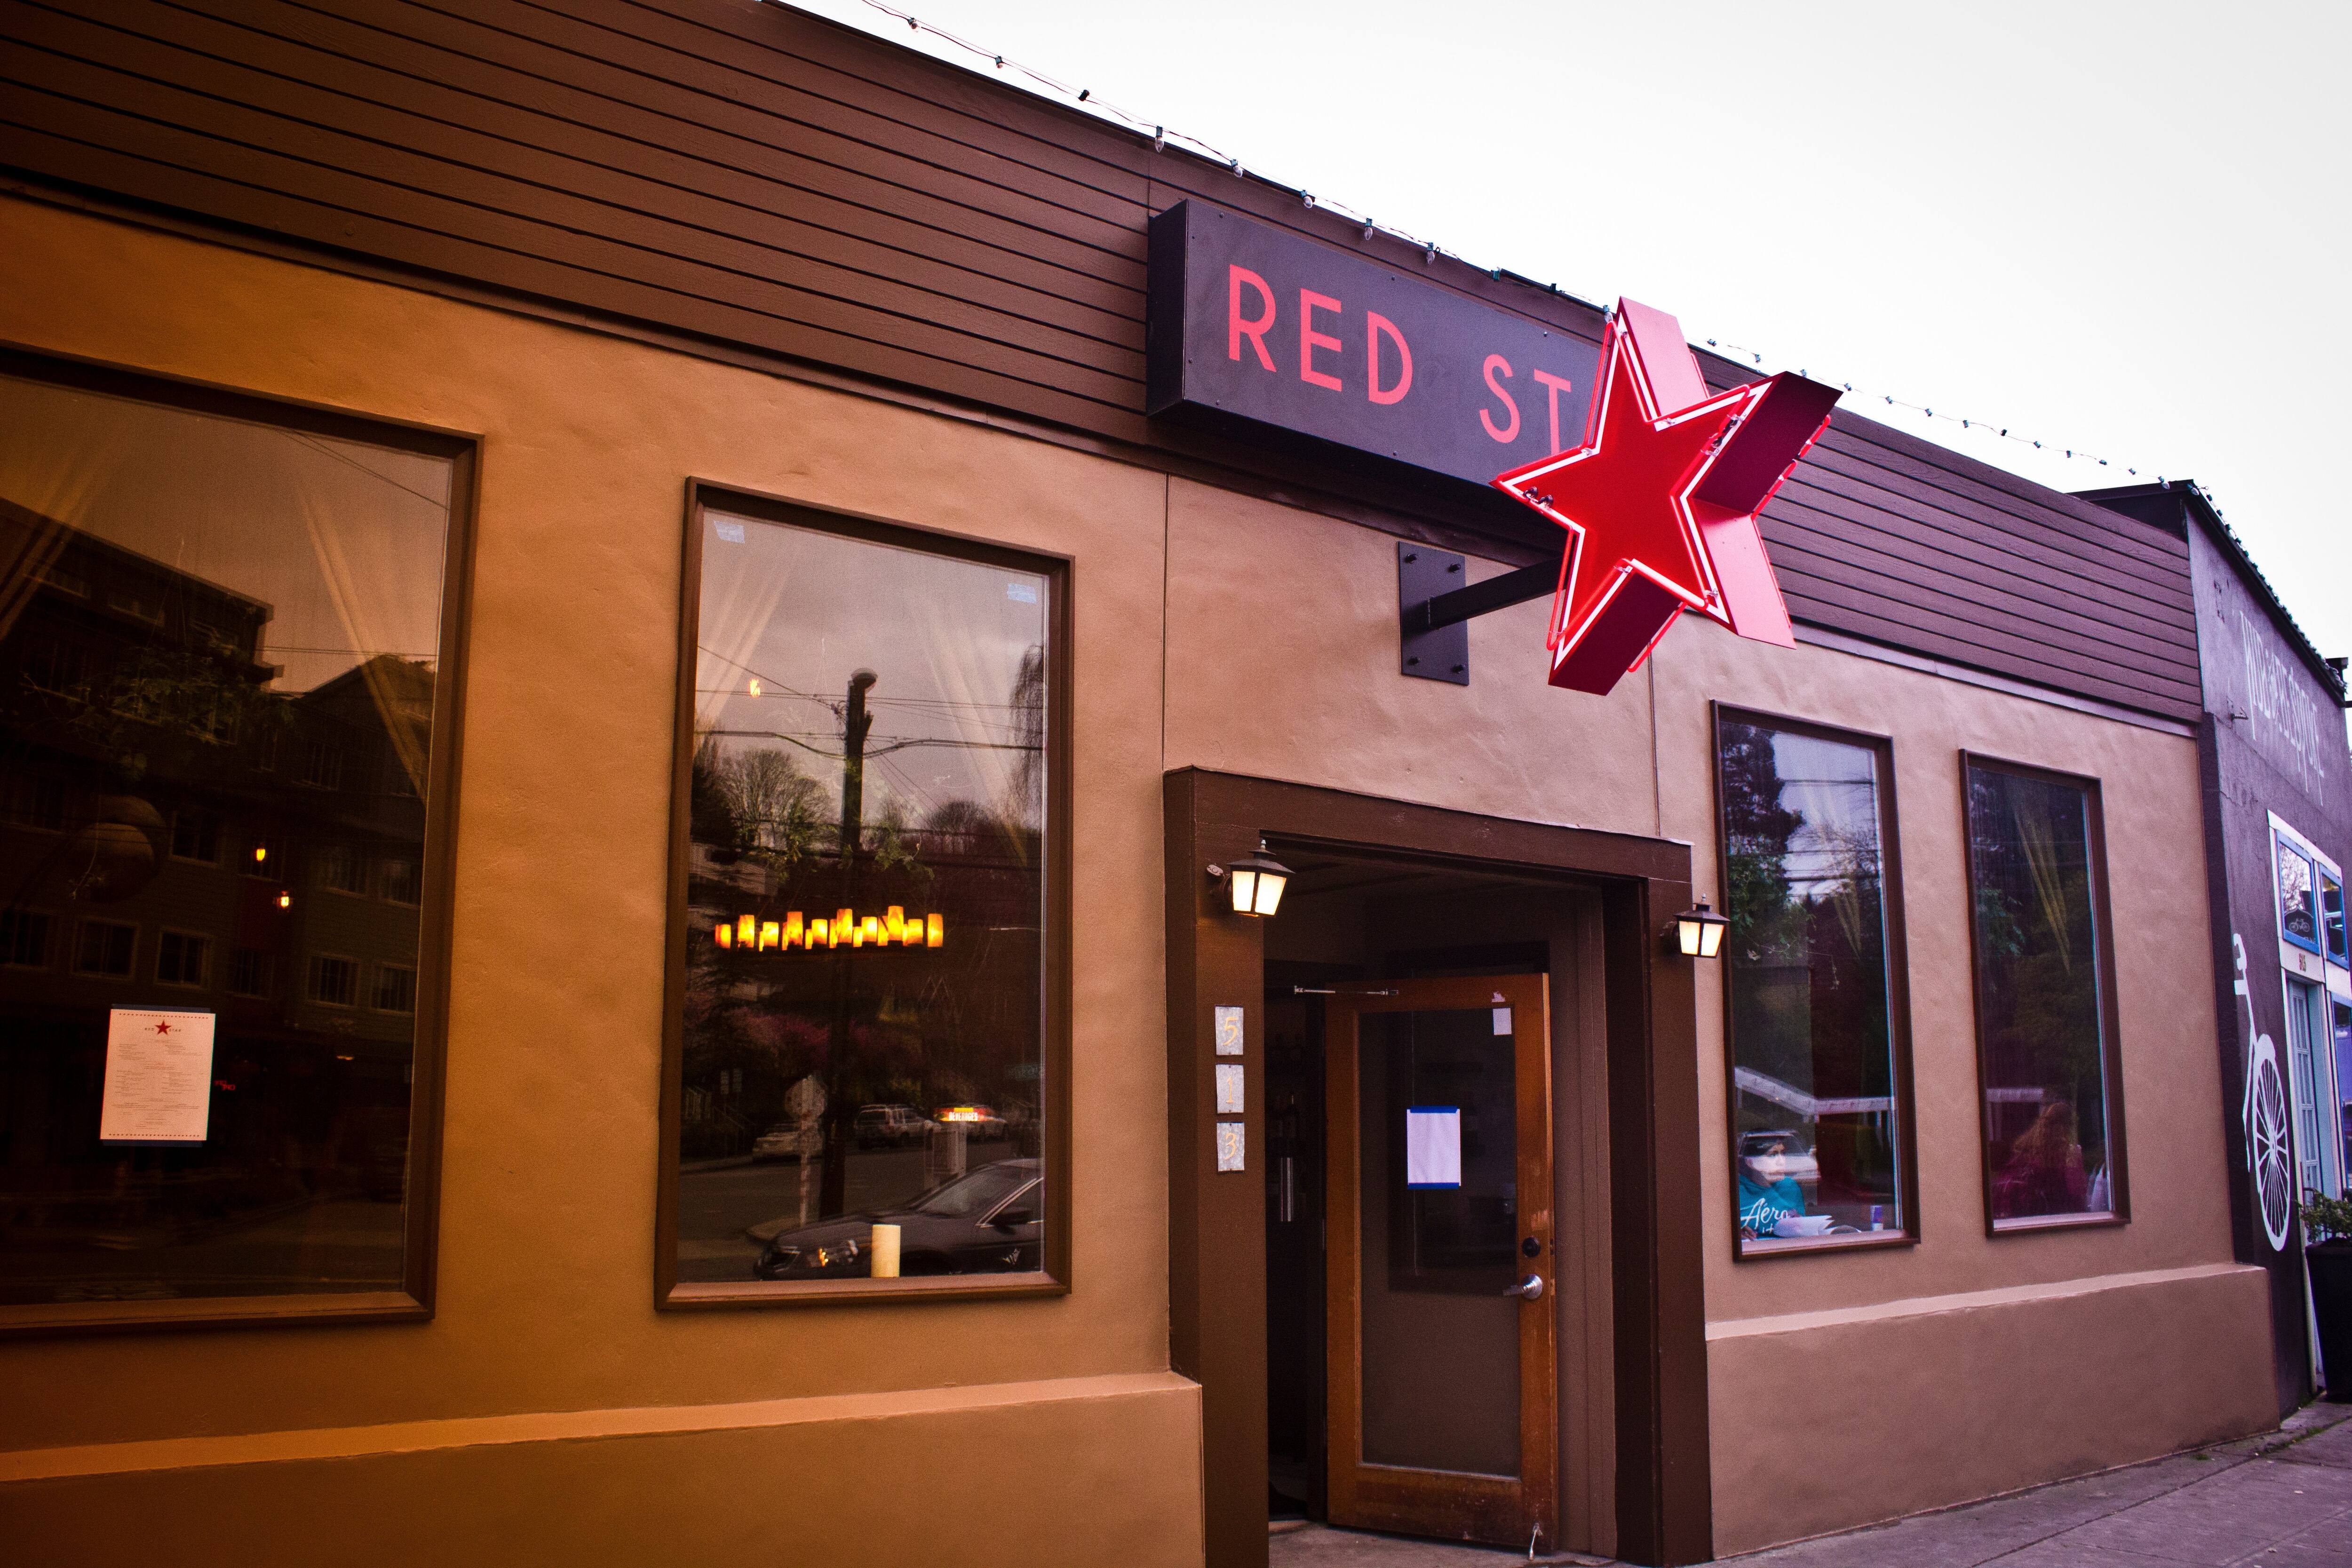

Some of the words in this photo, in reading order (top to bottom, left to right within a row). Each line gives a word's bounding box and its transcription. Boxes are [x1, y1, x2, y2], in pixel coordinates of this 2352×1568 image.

[1229, 264, 1414, 405] RED
[1479, 354, 1572, 455] ST
[949, 1112, 978, 1121] BEVERAGES
